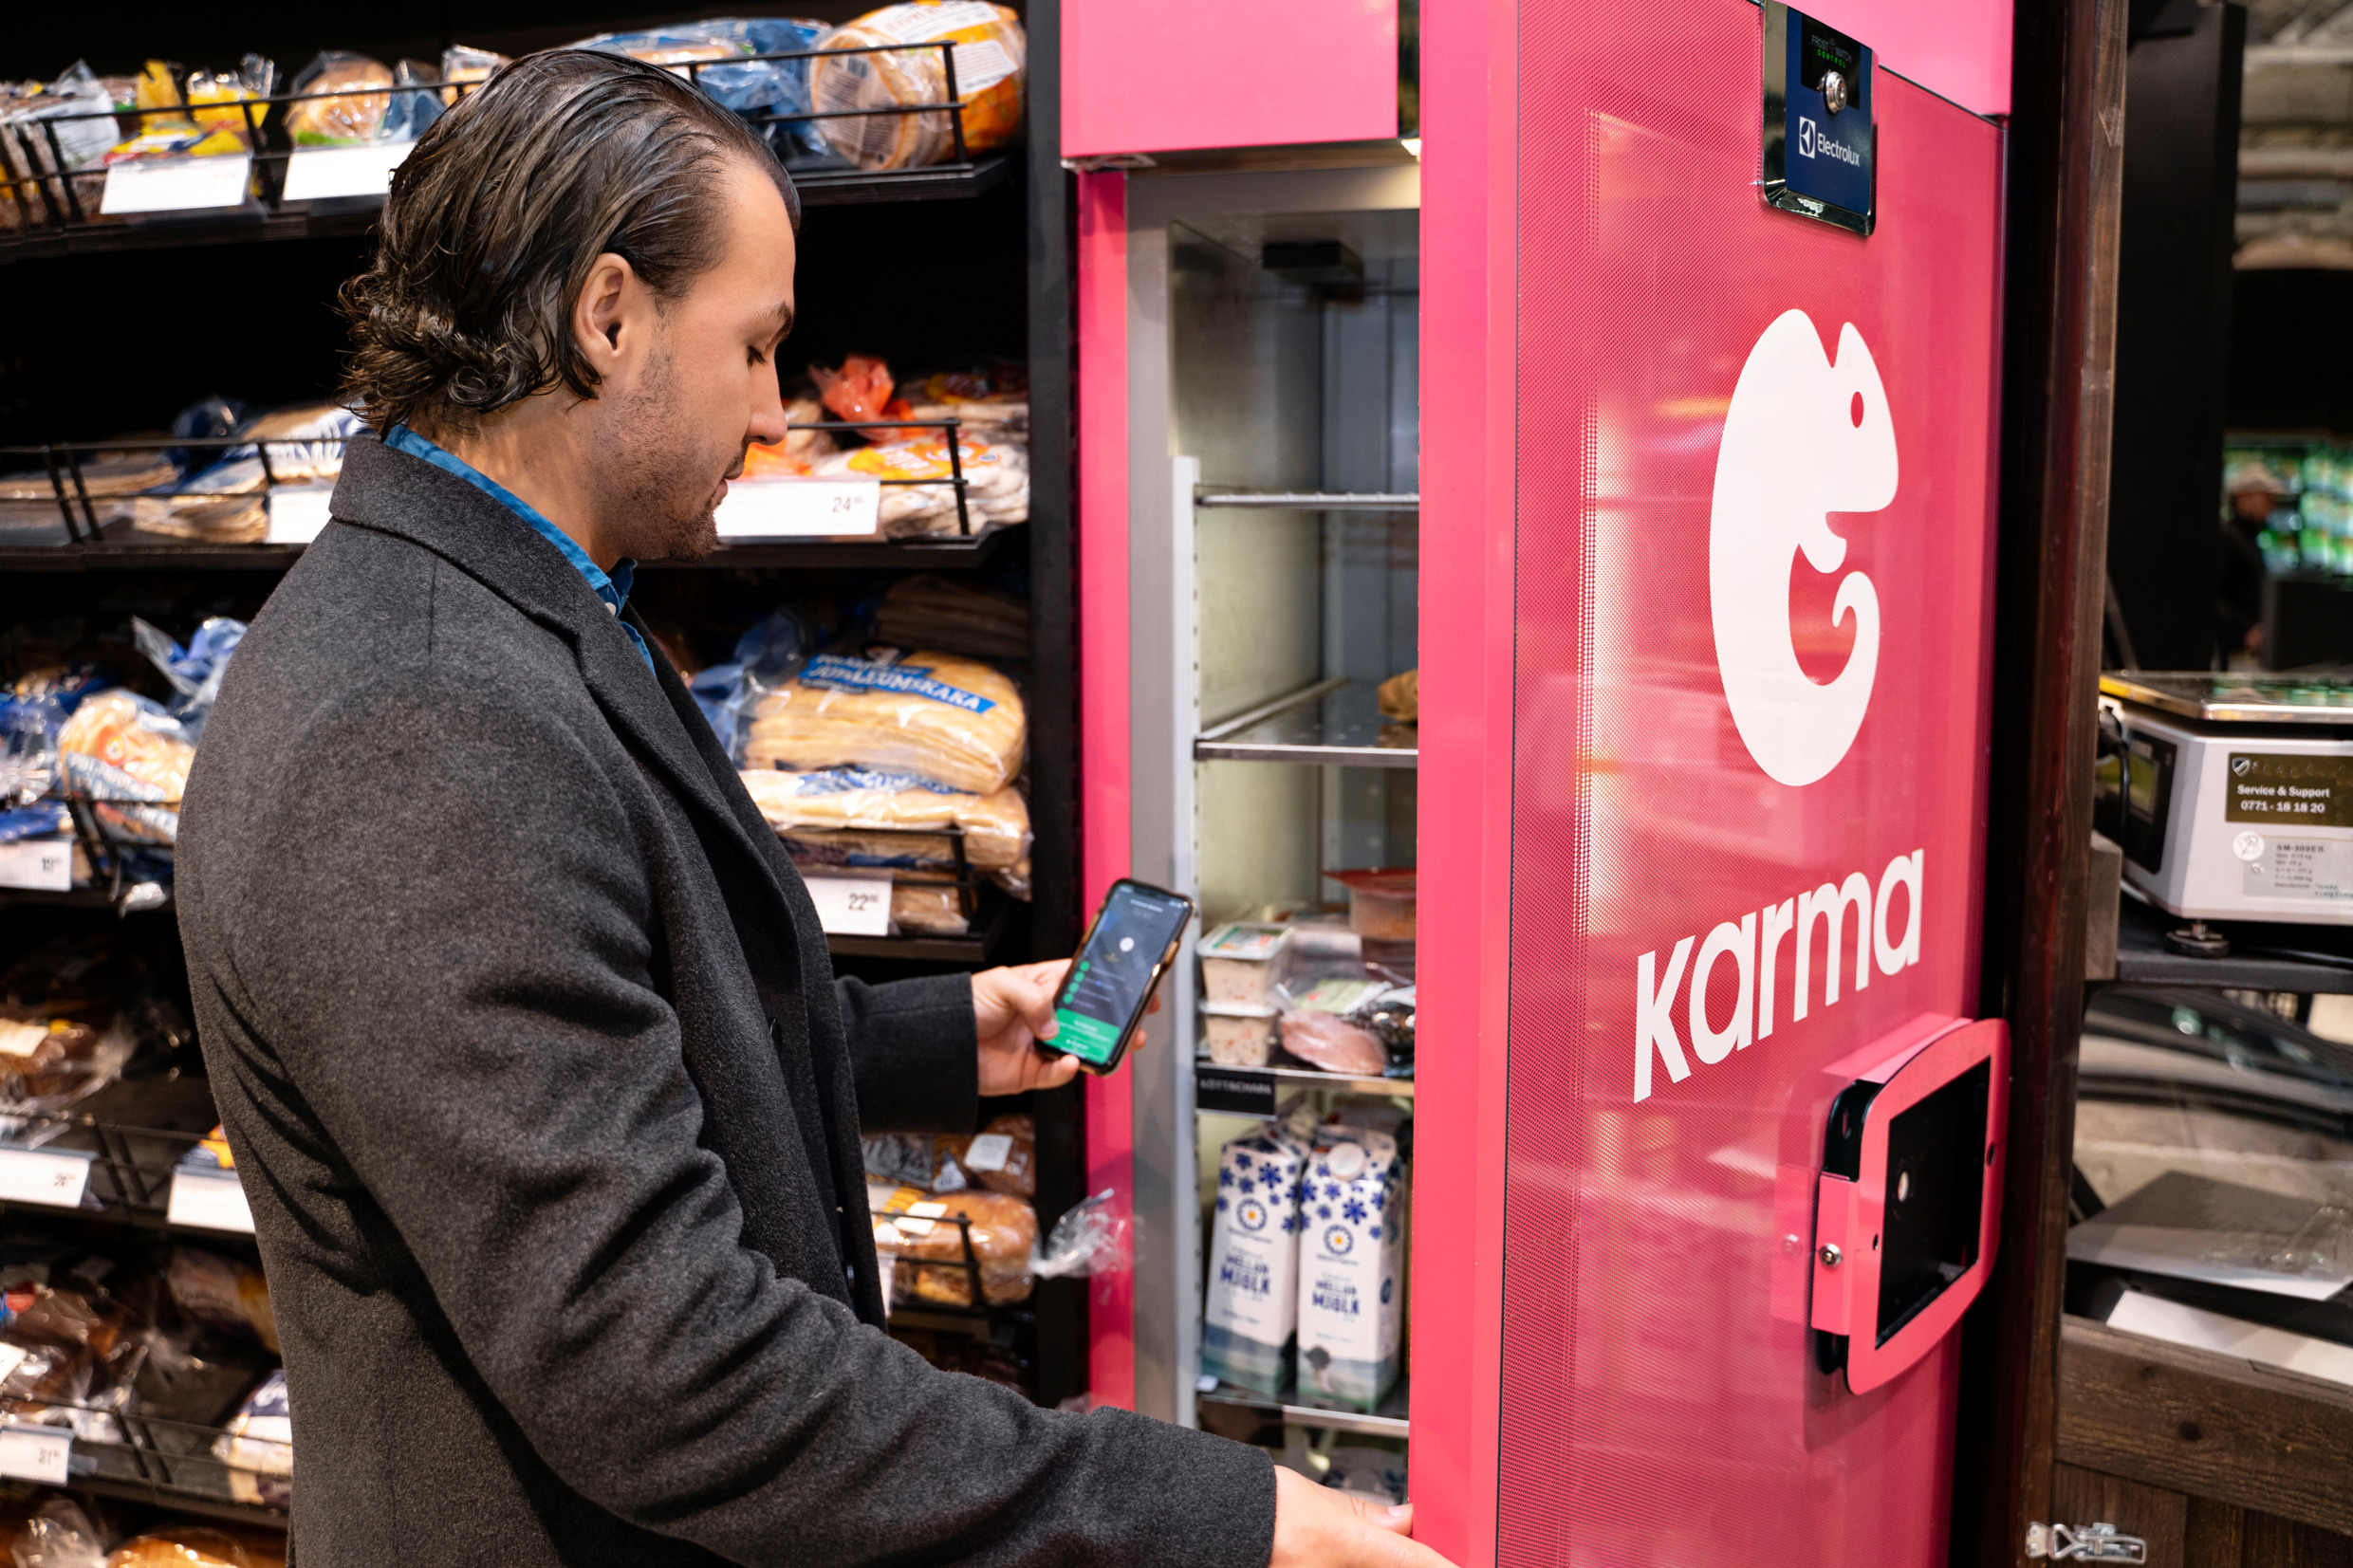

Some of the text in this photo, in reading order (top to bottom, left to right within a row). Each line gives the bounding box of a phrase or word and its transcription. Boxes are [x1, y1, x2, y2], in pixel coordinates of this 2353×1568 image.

[1811, 34, 1852, 63] FROST WATCH
[1817, 48, 1846, 68] CONTROL
[1817, 132, 1861, 167] Electrolux
[2237, 784, 2330, 799] Service & Support
[2240, 800, 2269, 811] 0771
[2276, 801, 2291, 812] 18
[2293, 802, 2308, 812] 18
[2309, 802, 2325, 813] 20
[1634, 848, 1924, 1104] karma
